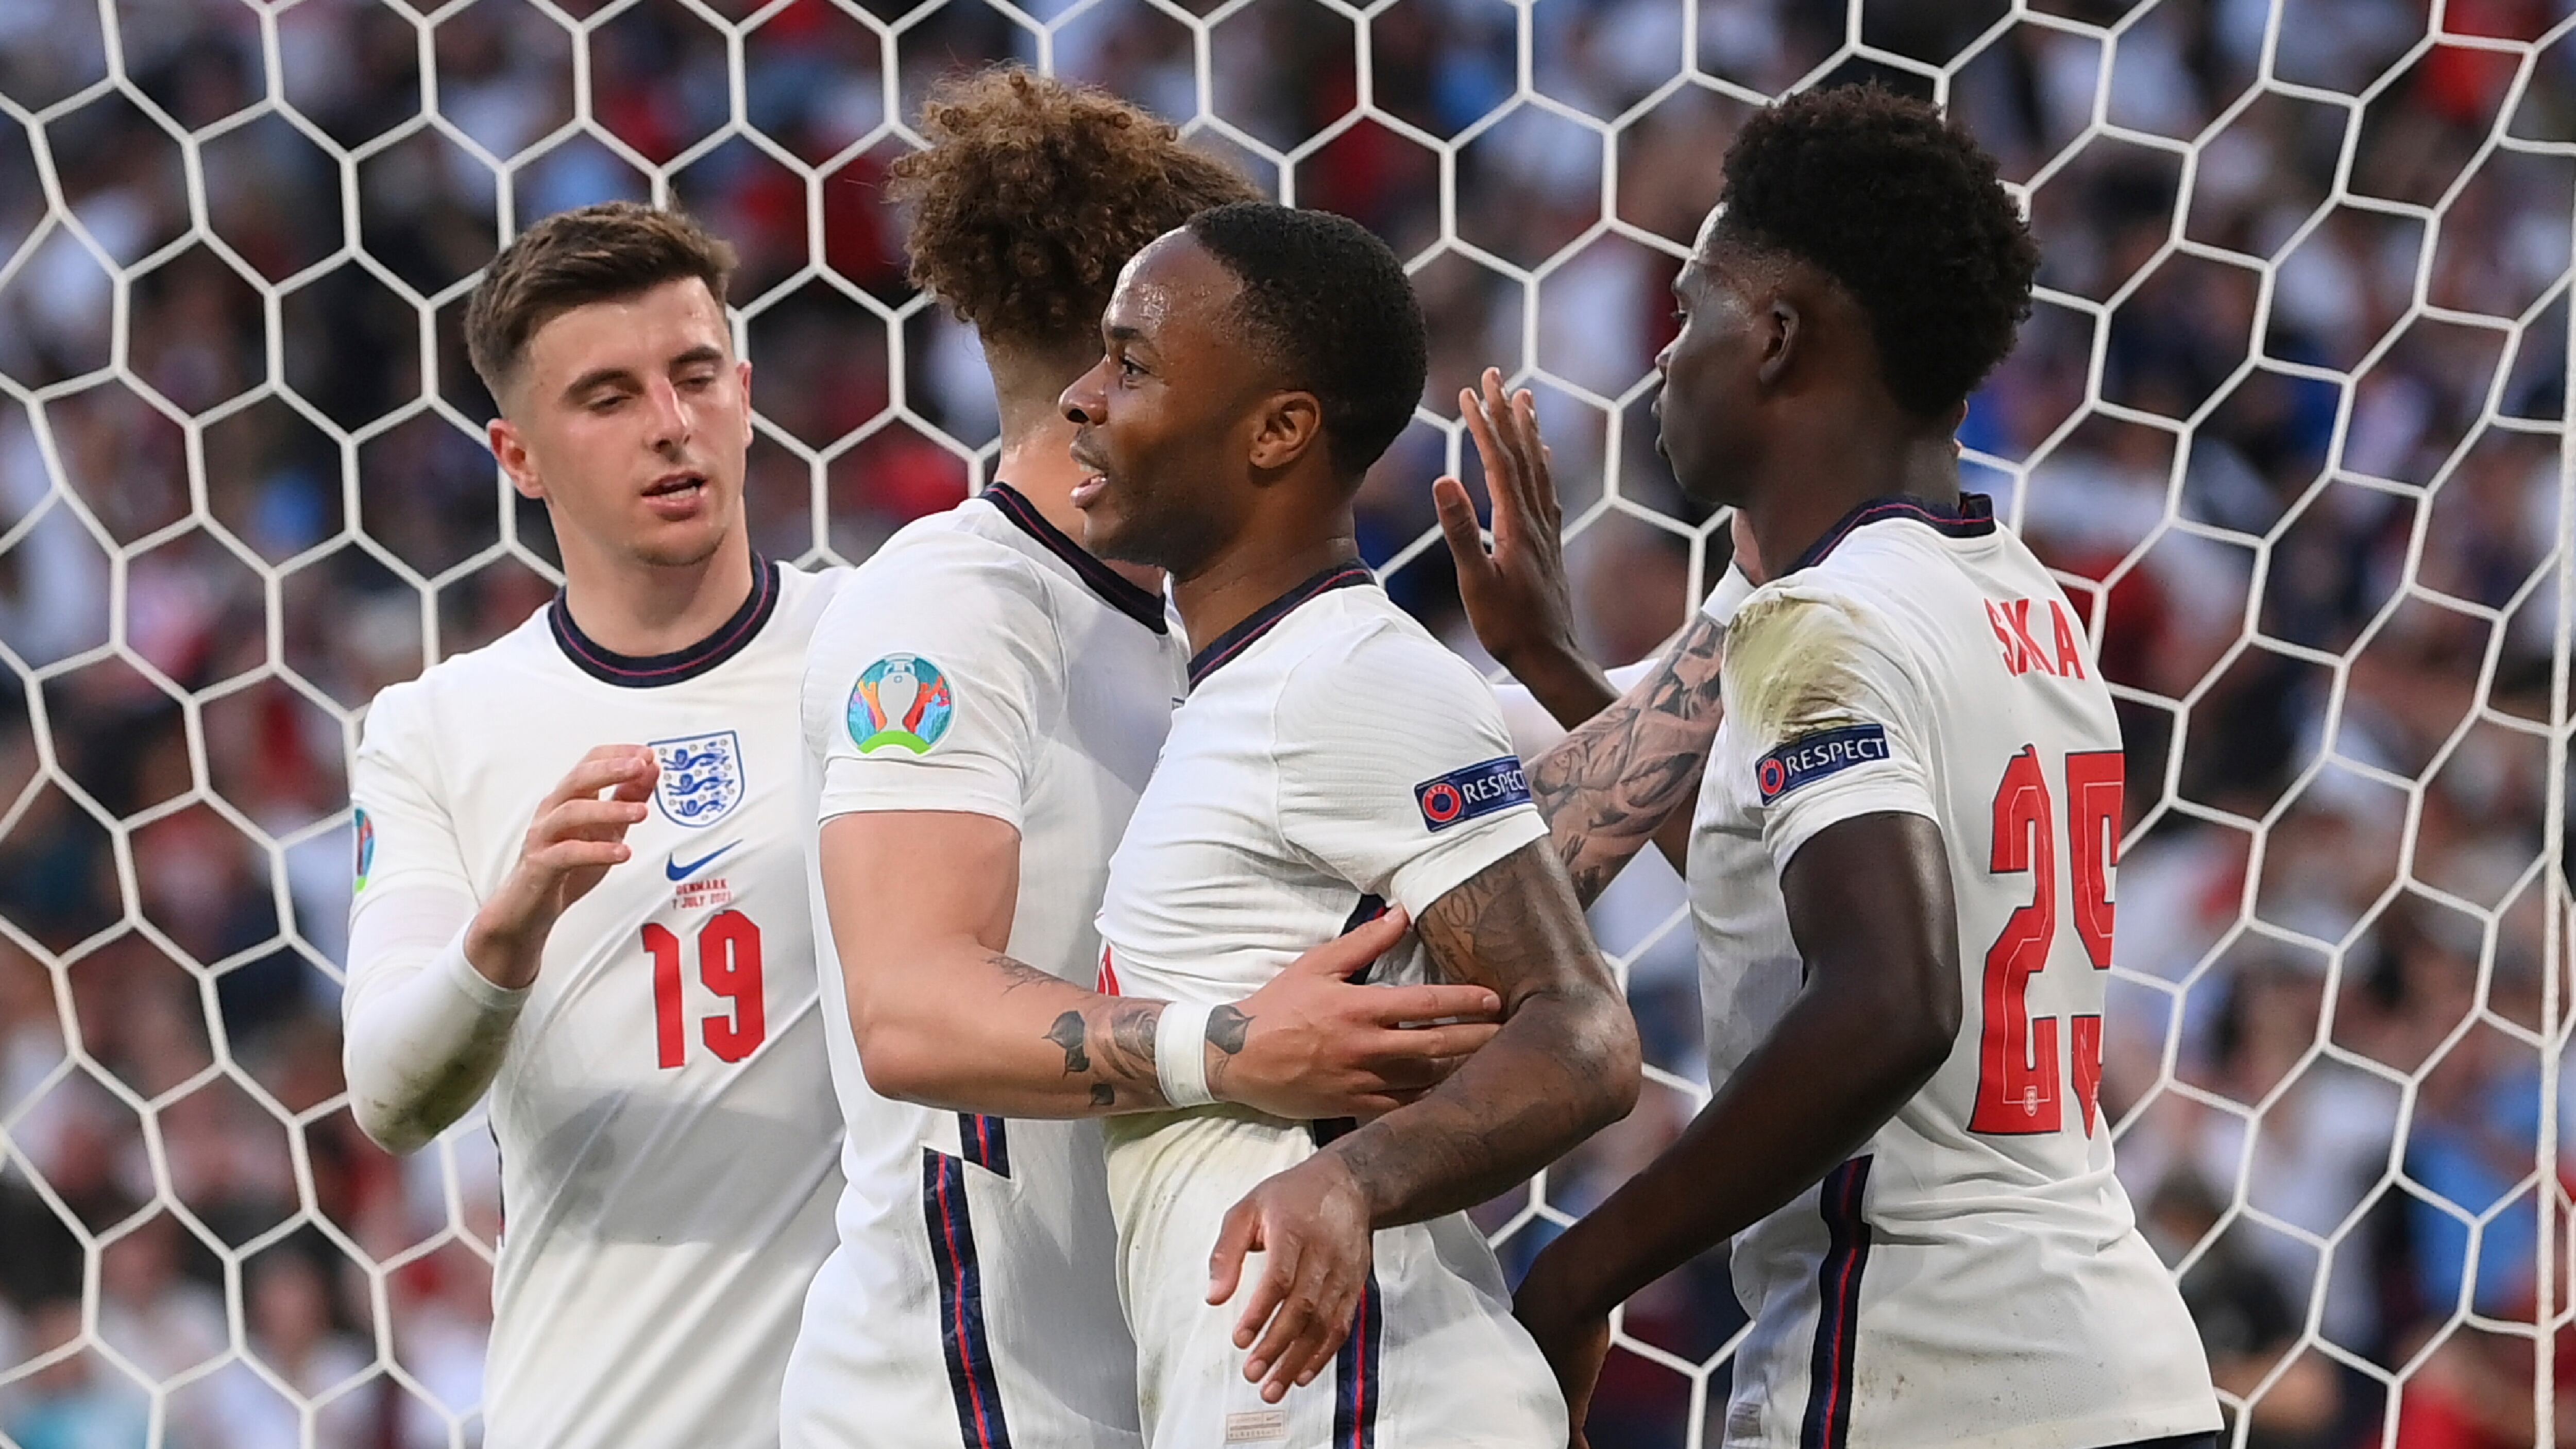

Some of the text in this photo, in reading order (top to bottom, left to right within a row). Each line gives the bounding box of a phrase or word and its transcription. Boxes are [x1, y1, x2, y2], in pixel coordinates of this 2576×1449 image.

[1984, 598, 2086, 680] SKA
[1785, 738, 1885, 777] RESPECT
[640, 909, 766, 1070] 19
[1966, 743, 2125, 1140] 25
